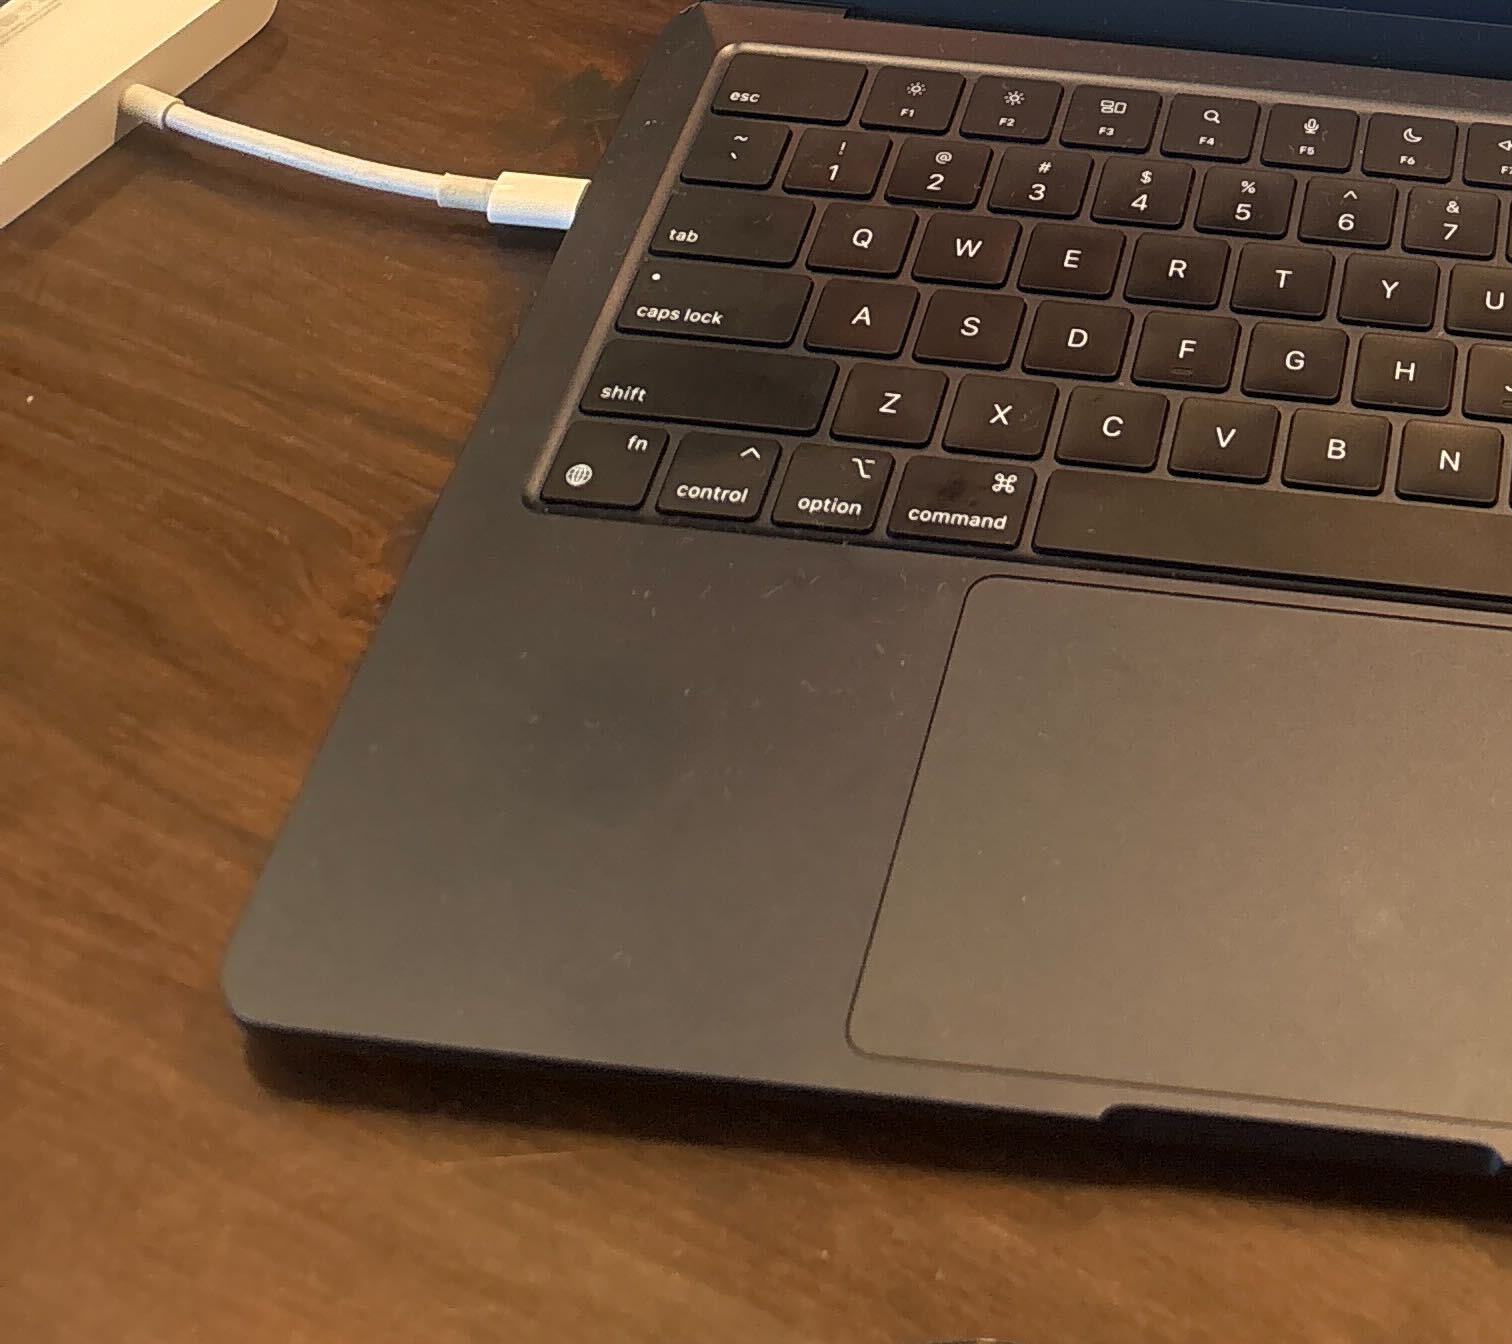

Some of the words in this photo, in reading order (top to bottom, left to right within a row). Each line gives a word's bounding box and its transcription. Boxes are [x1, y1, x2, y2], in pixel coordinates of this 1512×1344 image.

[730, 92, 759, 102] esc
[670, 229, 698, 242] tab
[853, 229, 872, 248] Q
[957, 239, 982, 257] W
[1064, 250, 1081, 268] E
[1169, 260, 1186, 278] R
[1276, 270, 1292, 288] T
[1382, 280, 1399, 298] Y
[1486, 291, 1504, 309] U
[637, 307, 680, 321] caps
[684, 309, 722, 324] lock
[852, 307, 870, 325] A
[961, 317, 980, 336] S
[1068, 329, 1088, 347] D
[1179, 340, 1196, 358] F
[1286, 351, 1304, 370] G
[1395, 361, 1415, 381] H
[601, 386, 646, 401] shift
[879, 393, 901, 413] Z
[990, 404, 1012, 425] X
[1103, 416, 1123, 436] C
[628, 435, 647, 450] fn
[1217, 427, 1236, 447] V
[1328, 439, 1345, 459] B
[1440, 450, 1460, 471] N
[677, 485, 748, 502] control
[798, 498, 861, 514] option
[909, 509, 1007, 529] command
